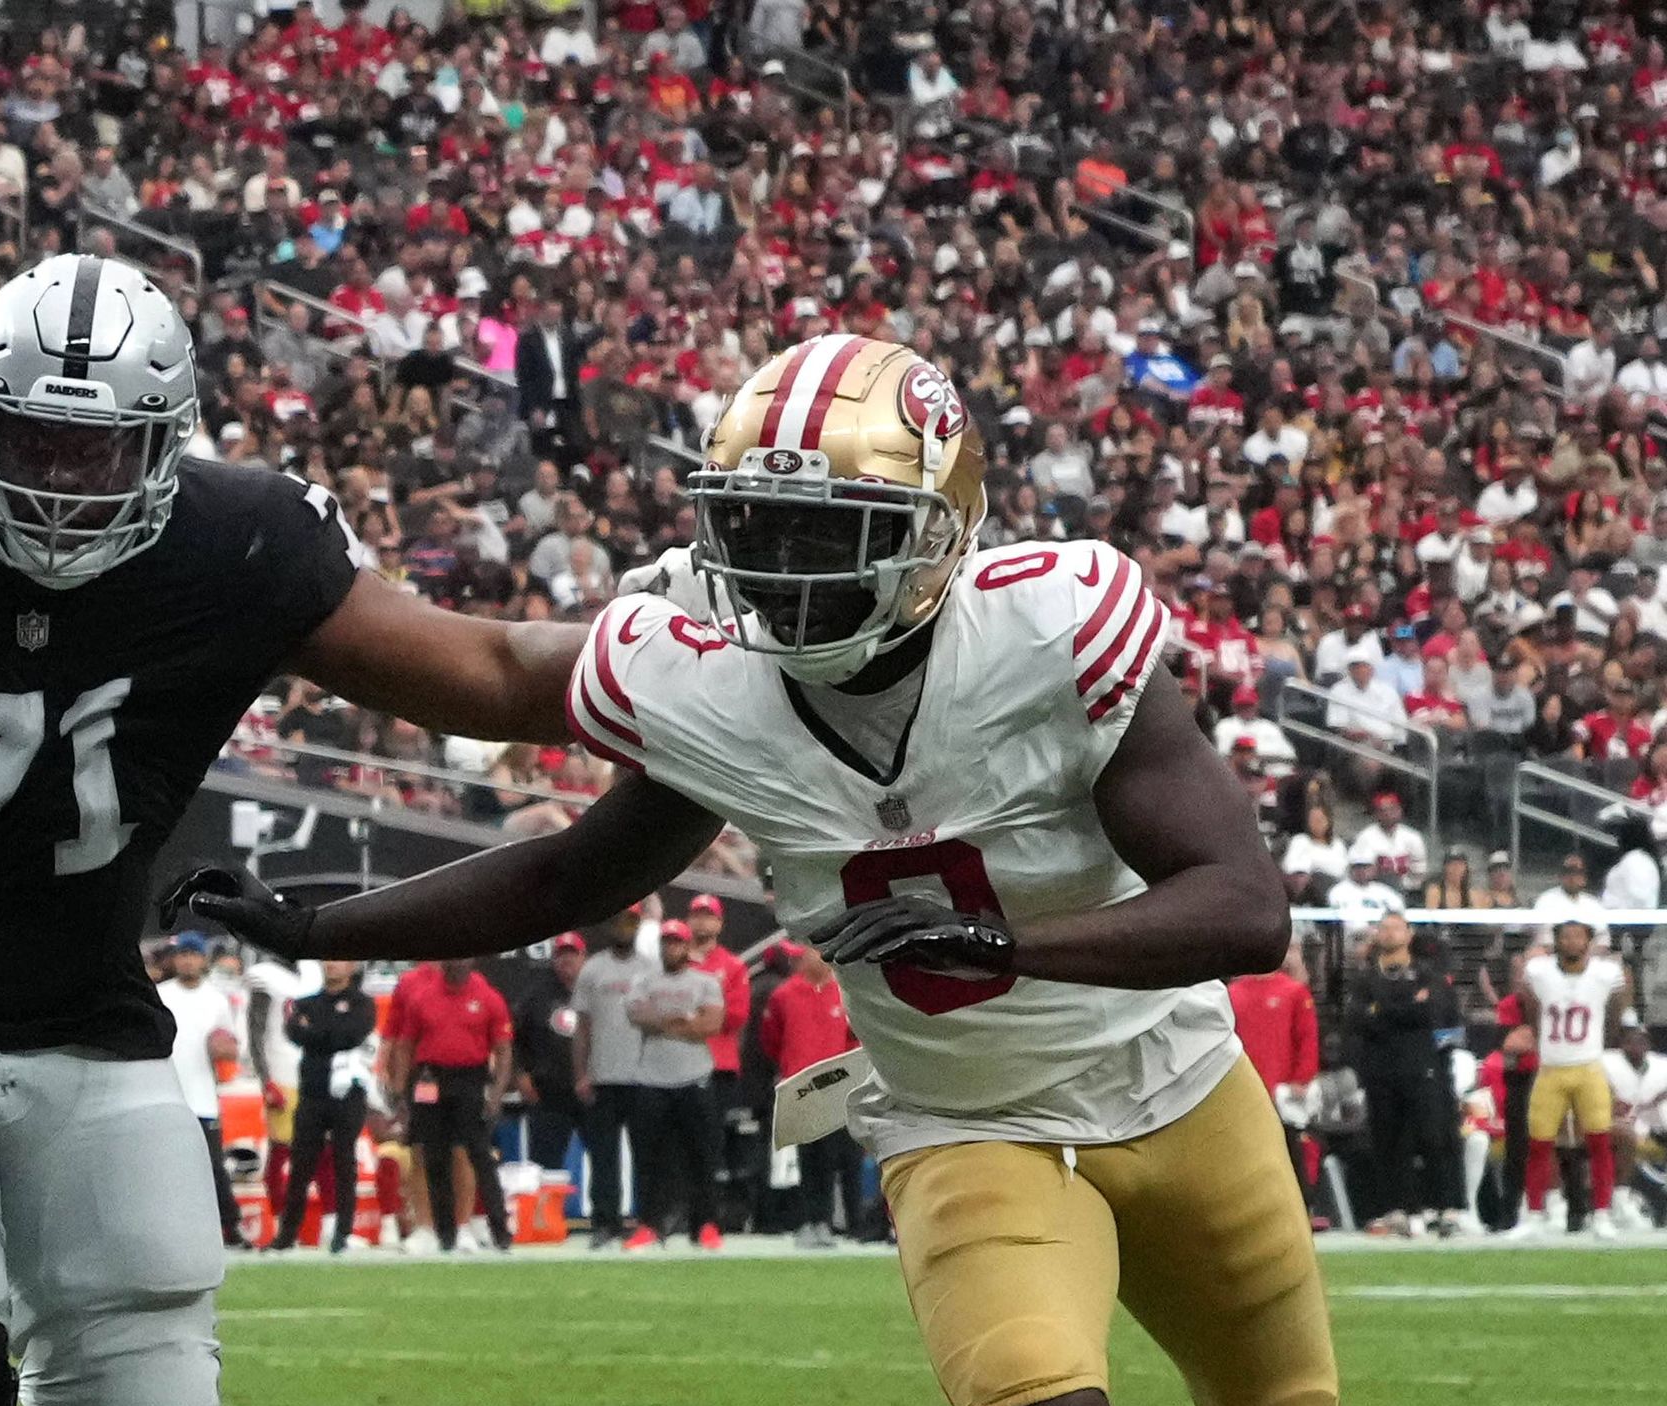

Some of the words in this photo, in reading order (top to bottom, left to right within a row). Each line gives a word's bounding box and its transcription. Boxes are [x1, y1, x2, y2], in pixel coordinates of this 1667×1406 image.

[45, 384, 98, 399] RAIDERS
[974, 551, 1059, 590] 0
[1547, 1004, 1590, 1044] 10
